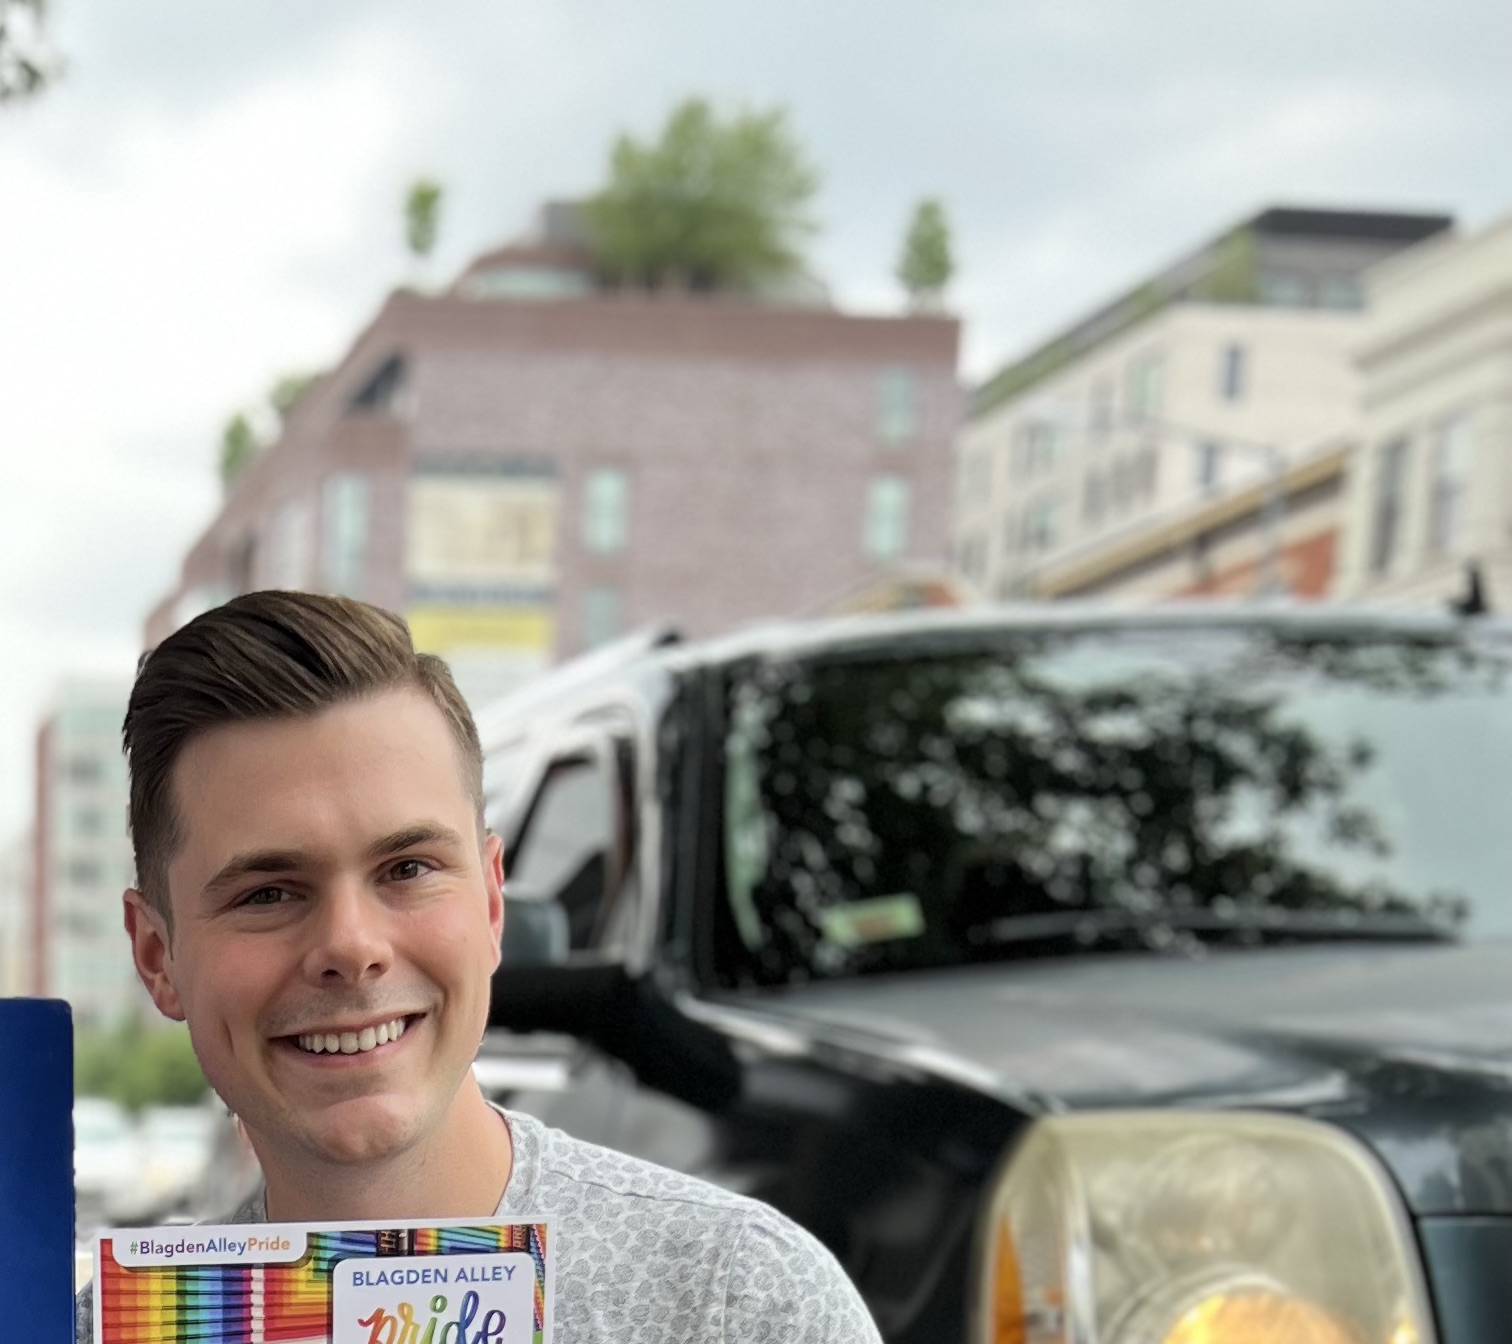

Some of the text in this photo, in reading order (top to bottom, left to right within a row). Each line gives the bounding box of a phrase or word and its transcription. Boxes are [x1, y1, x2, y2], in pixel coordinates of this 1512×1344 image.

[129, 1237, 291, 1259] #BlagdenAlleyPride
[352, 1265, 517, 1287] BLAGDEN ALLEY
